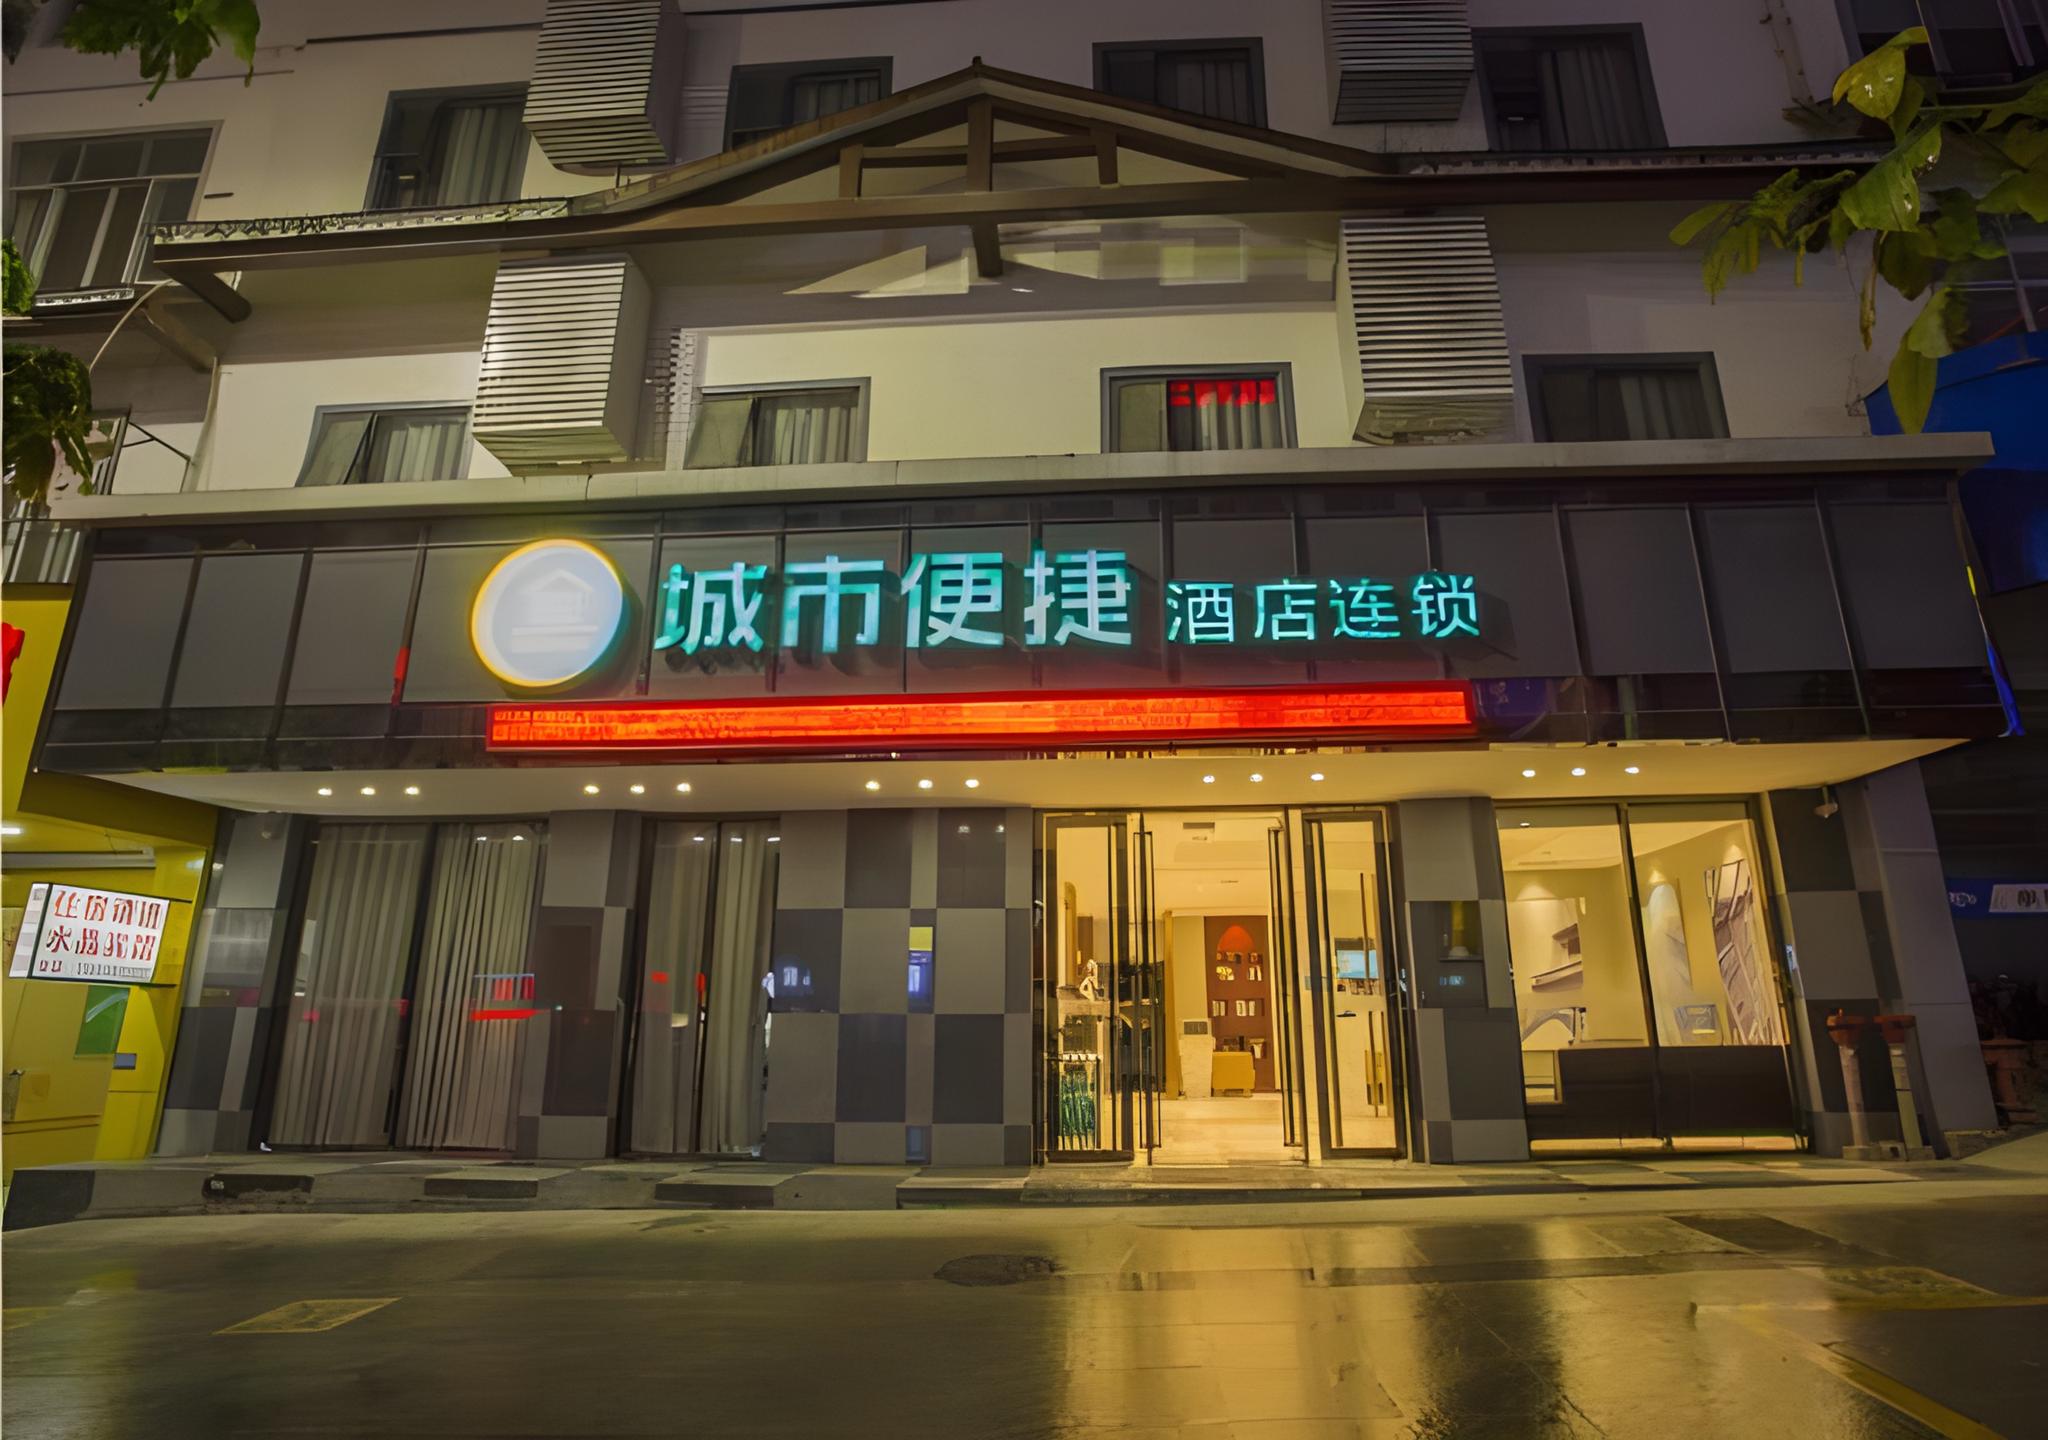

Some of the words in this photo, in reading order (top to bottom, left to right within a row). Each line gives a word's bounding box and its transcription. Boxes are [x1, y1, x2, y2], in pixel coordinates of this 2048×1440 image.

[653, 550, 1132, 655] 城市便捷
[1167, 574, 1481, 645] 酒店连锁
